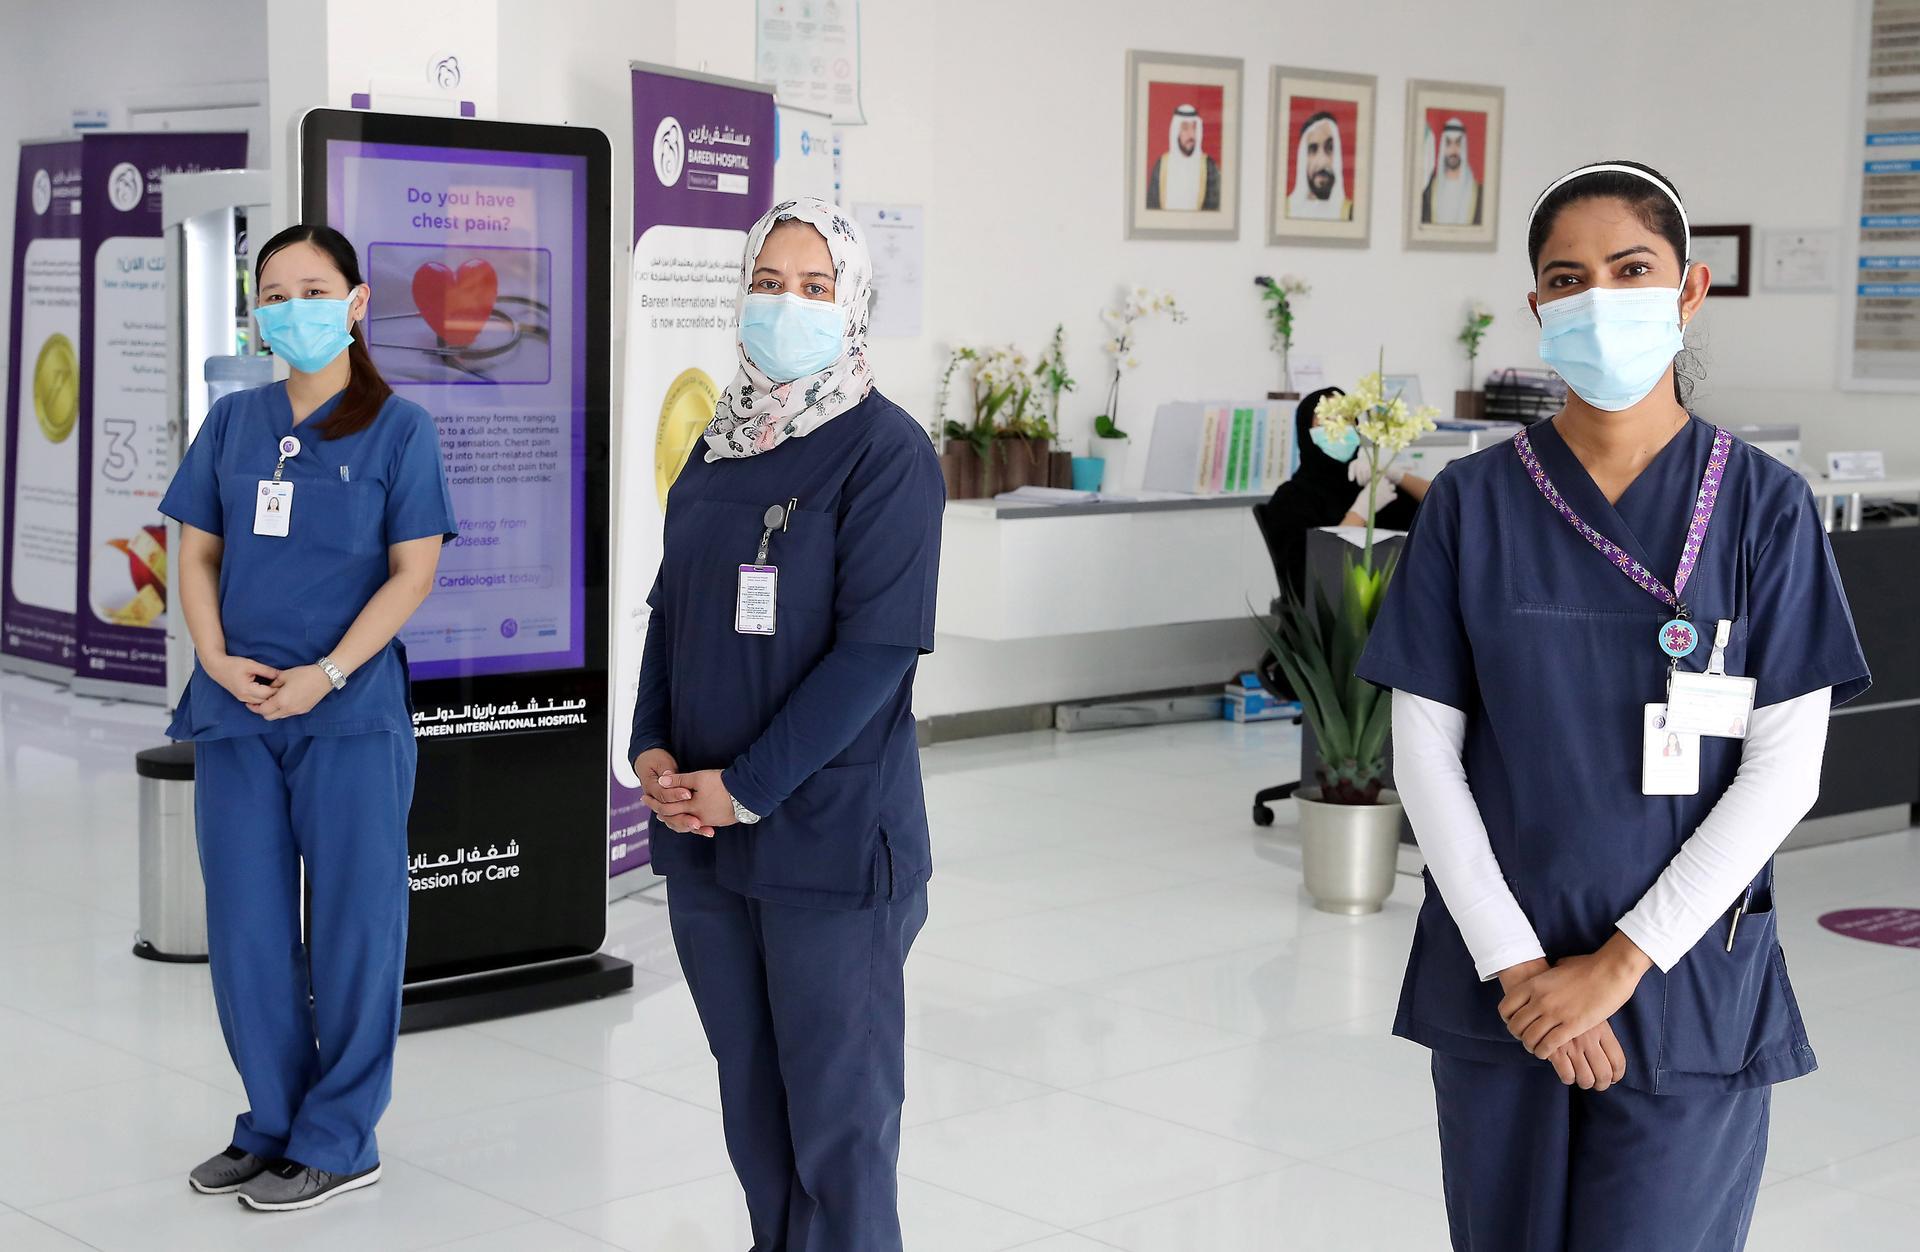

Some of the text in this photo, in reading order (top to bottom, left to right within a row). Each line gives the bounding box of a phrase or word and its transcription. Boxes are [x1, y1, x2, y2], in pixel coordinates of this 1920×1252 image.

[688, 149, 749, 169] BAREEN HOSPITAL
[408, 188, 515, 207] Do you have
[412, 213, 511, 232] chest pain?
[641, 294, 669, 308] Bareen
[671, 296, 717, 308] International
[651, 316, 657, 328] is
[660, 318, 673, 328] now
[676, 316, 715, 328] accredited
[717, 316, 727, 331] by
[467, 415, 491, 424] many
[494, 414, 519, 422] forms,
[523, 414, 556, 424] ranging
[448, 427, 457, 435] to
[468, 426, 484, 435] dull
[487, 426, 510, 435] ache,
[513, 426, 559, 434] sometimes
[102, 418, 138, 482] 3
[457, 439, 500, 448] sensation.
[504, 438, 529, 447] Chest
[532, 438, 550, 448] pain
[455, 451, 472, 460] into
[475, 450, 533, 459] heart-related
[535, 450, 558, 458] chest
[454, 463, 478, 473] pain)
[492, 463, 515, 471] chest
[518, 462, 537, 472] pain
[539, 462, 556, 471] that
[451, 476, 494, 484] condition
[496, 475, 552, 484] (non-cardiac
[457, 518, 527, 531] ffering from
[455, 535, 501, 547] Disease.
[438, 573, 541, 587] Cardiologist today
[472, 703, 497, 721] بارين
[456, 718, 536, 734] INTERNATIONAL
[538, 714, 587, 727] HOSPITAL
[467, 839, 519, 862] شغف
[461, 868, 483, 884] for
[486, 865, 520, 880] Care
